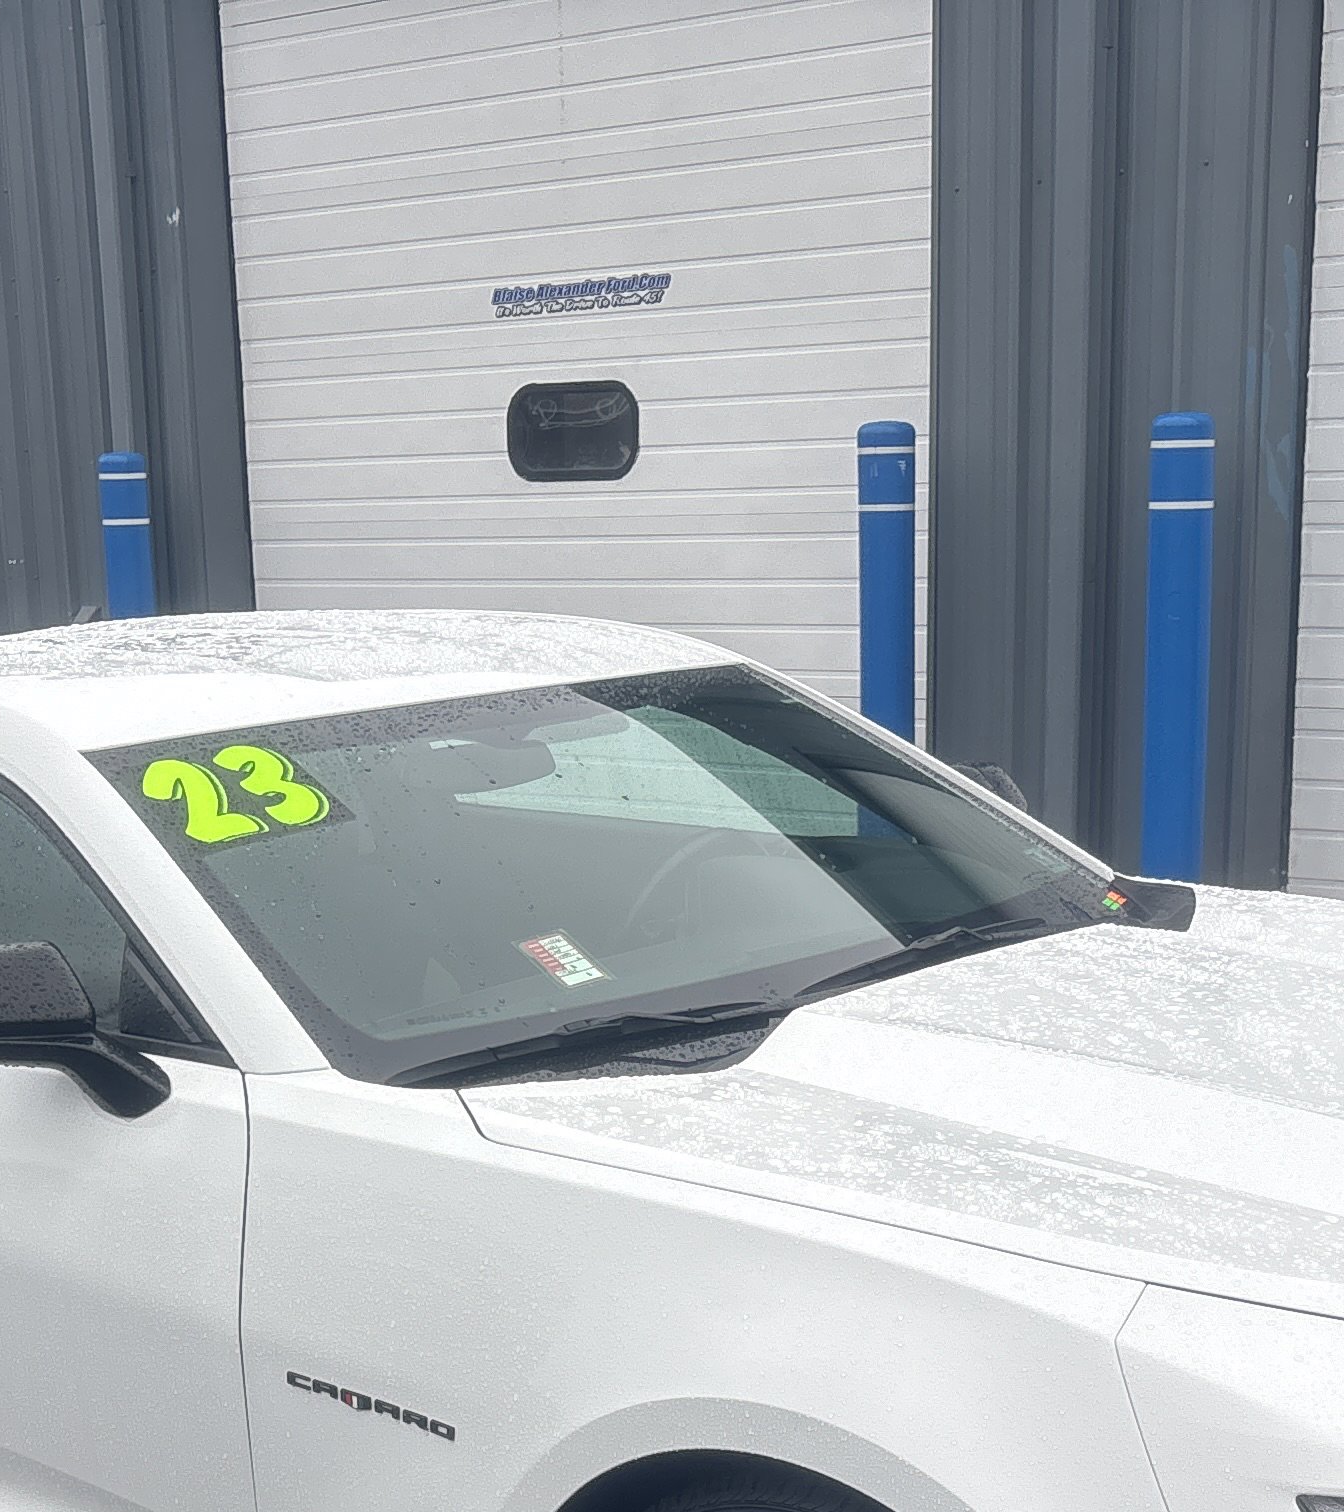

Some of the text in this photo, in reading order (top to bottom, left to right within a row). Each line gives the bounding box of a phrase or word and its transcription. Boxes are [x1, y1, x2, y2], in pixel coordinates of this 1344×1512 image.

[536, 279, 606, 300] Alexander
[545, 300, 564, 313] The
[595, 296, 610, 309] To
[142, 744, 330, 844] 23
